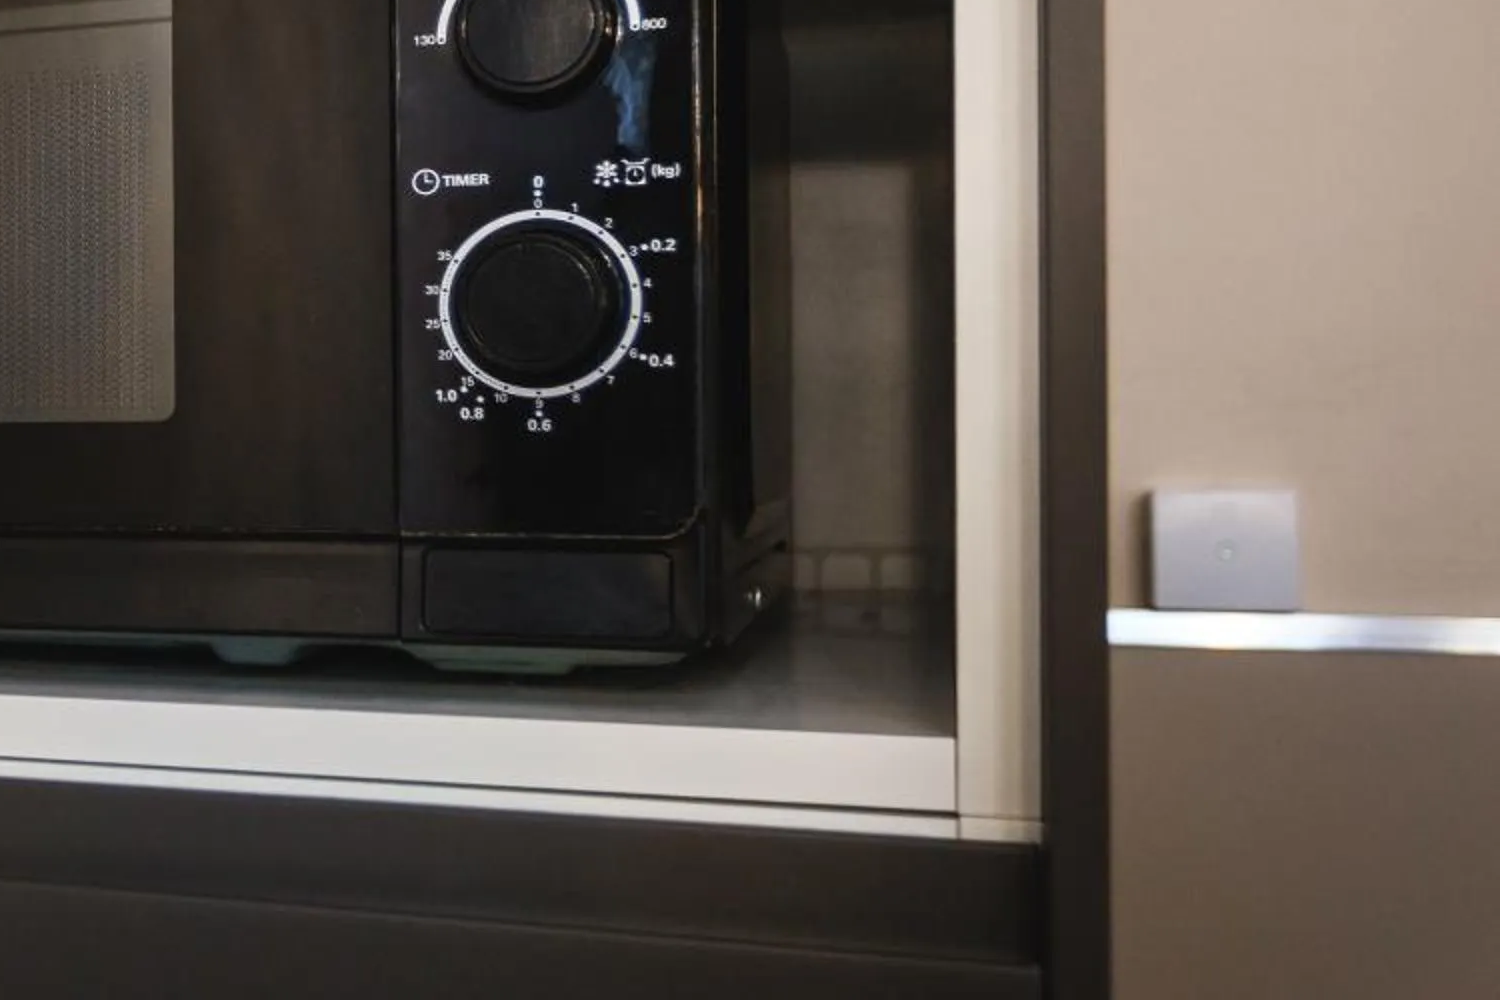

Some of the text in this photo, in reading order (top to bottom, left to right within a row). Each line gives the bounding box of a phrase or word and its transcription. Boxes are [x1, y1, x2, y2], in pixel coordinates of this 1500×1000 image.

[641, 17, 667, 30] 800
[413, 34, 436, 46] 130
[651, 162, 681, 179] (kg)
[442, 173, 490, 188] TIMER
[532, 175, 544, 188] 0
[533, 198, 543, 209] 0
[571, 202, 579, 213] 1
[604, 217, 613, 229] 2
[651, 238, 676, 252] 0.2
[437, 251, 451, 262] 35
[629, 245, 638, 257] 3
[643, 278, 652, 288] 4
[425, 285, 439, 296] 30
[643, 312, 652, 323] 5
[425, 319, 441, 330] 25
[438, 350, 453, 361] 20
[629, 347, 638, 359] 6
[649, 353, 675, 368] 0.4
[461, 376, 475, 387] 15
[607, 375, 616, 385] 7
[436, 388, 458, 403] 1.0
[494, 393, 508, 404] 10
[571, 392, 581, 403] 8
[535, 399, 545, 409] 9
[459, 407, 485, 421] 0.8
[527, 419, 552, 432] 0.6
